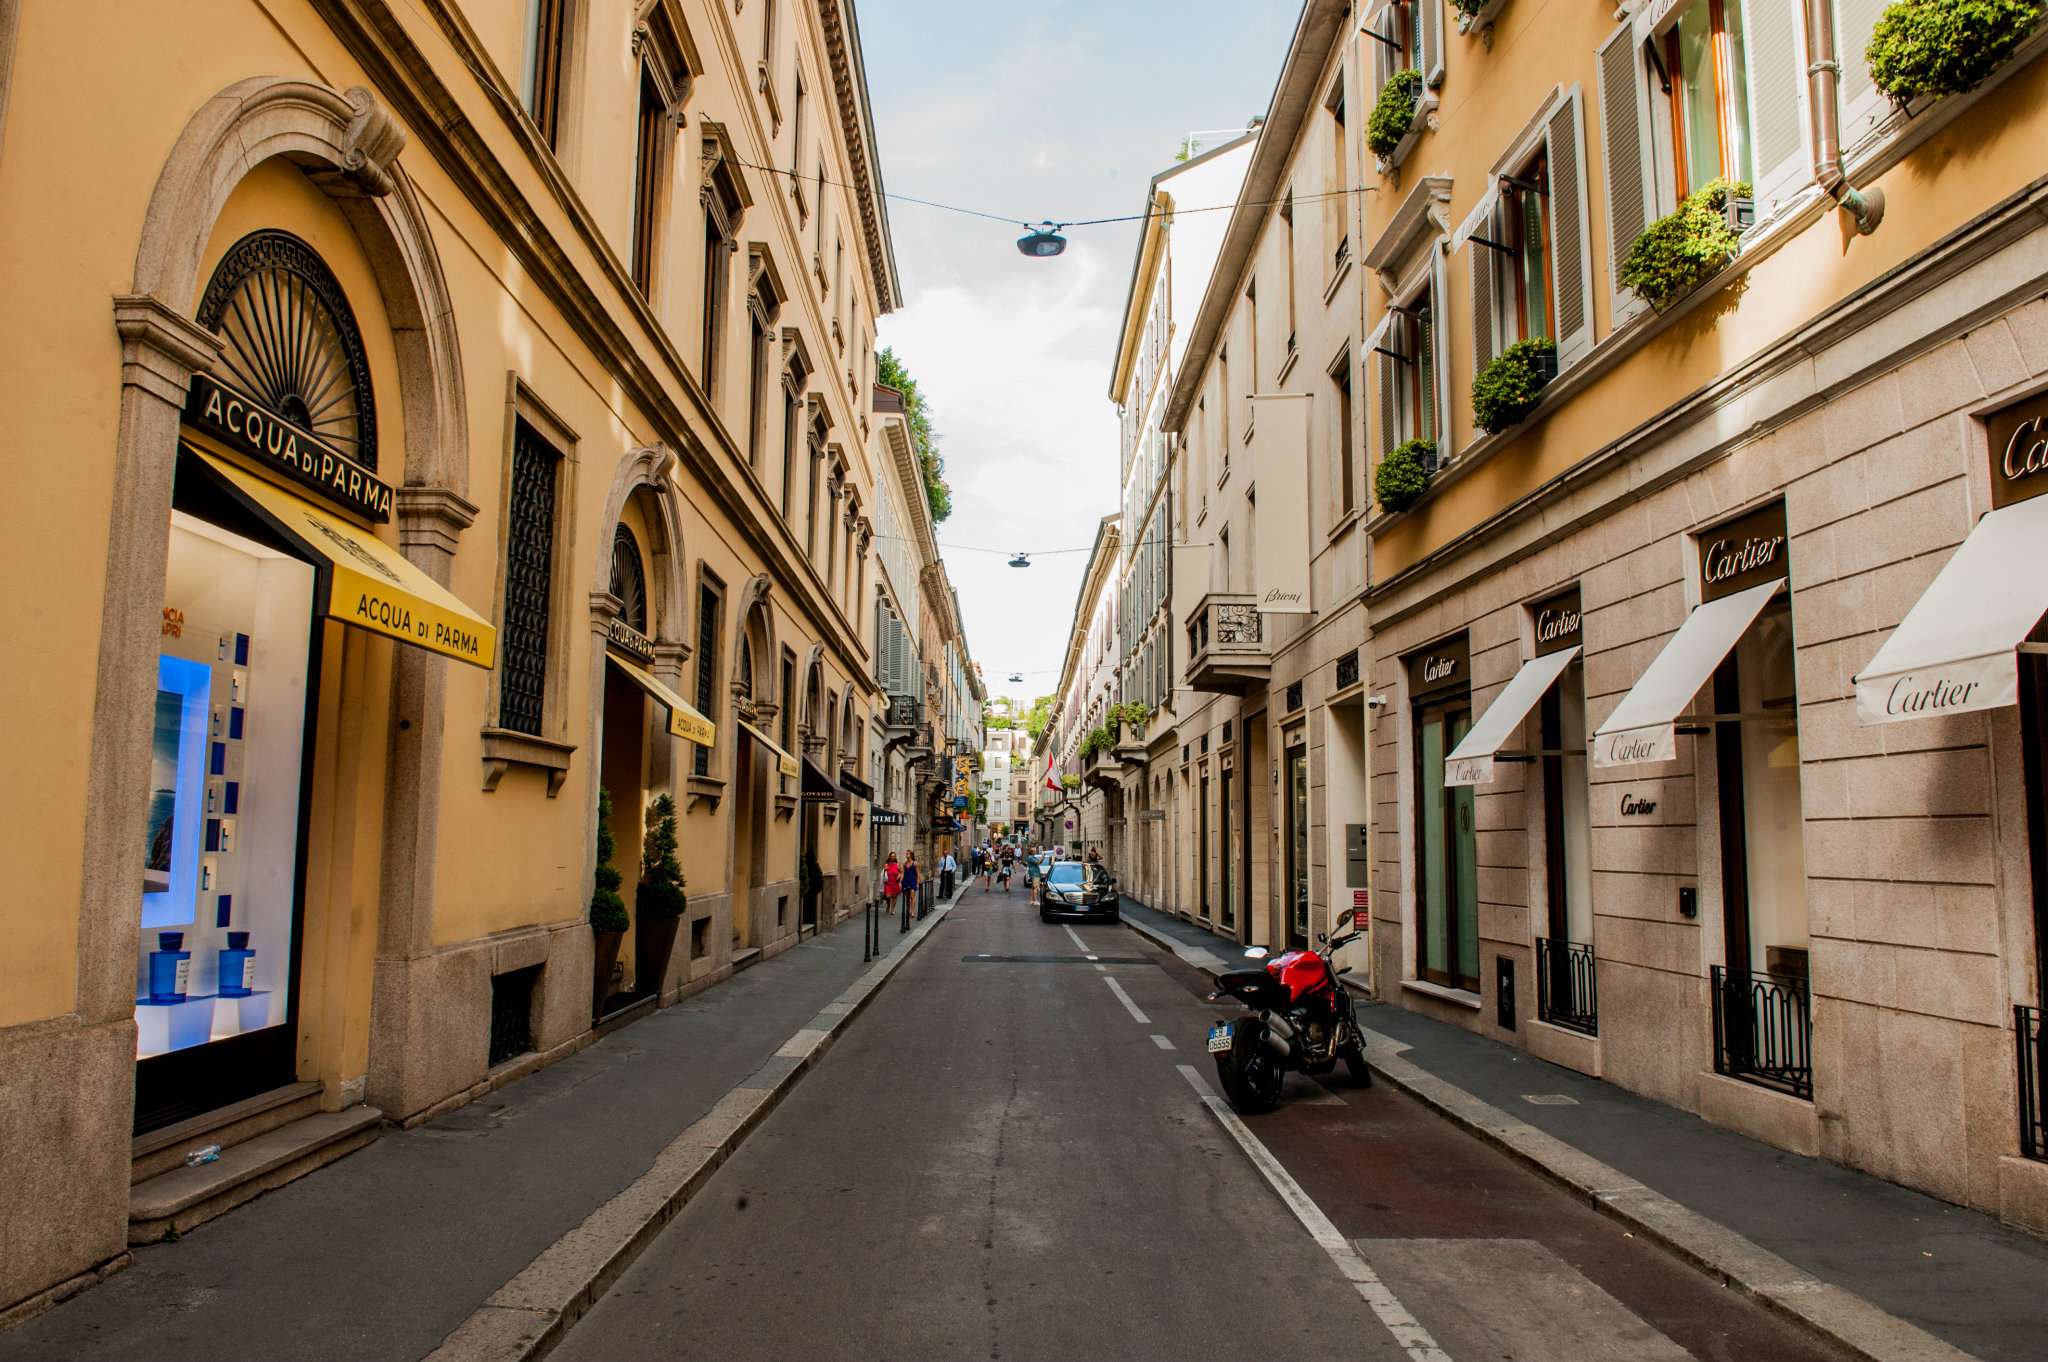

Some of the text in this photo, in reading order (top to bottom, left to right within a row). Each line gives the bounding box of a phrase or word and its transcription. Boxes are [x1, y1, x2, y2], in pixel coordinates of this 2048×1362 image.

[204, 389, 298, 467] ACQUA
[321, 453, 391, 516] PARMA
[1704, 534, 1785, 584] Cartier
[1264, 587, 1303, 604] Brioni
[357, 593, 411, 633] ACQUA
[435, 622, 478, 657] PARMA
[1538, 609, 1581, 643] Cartier
[1424, 655, 1456, 683] Cartier
[1886, 674, 1979, 716] Cartier
[1610, 734, 1656, 762] Cartier
[1455, 760, 1483, 782] Cartier
[1620, 793, 1657, 817] Cartier
